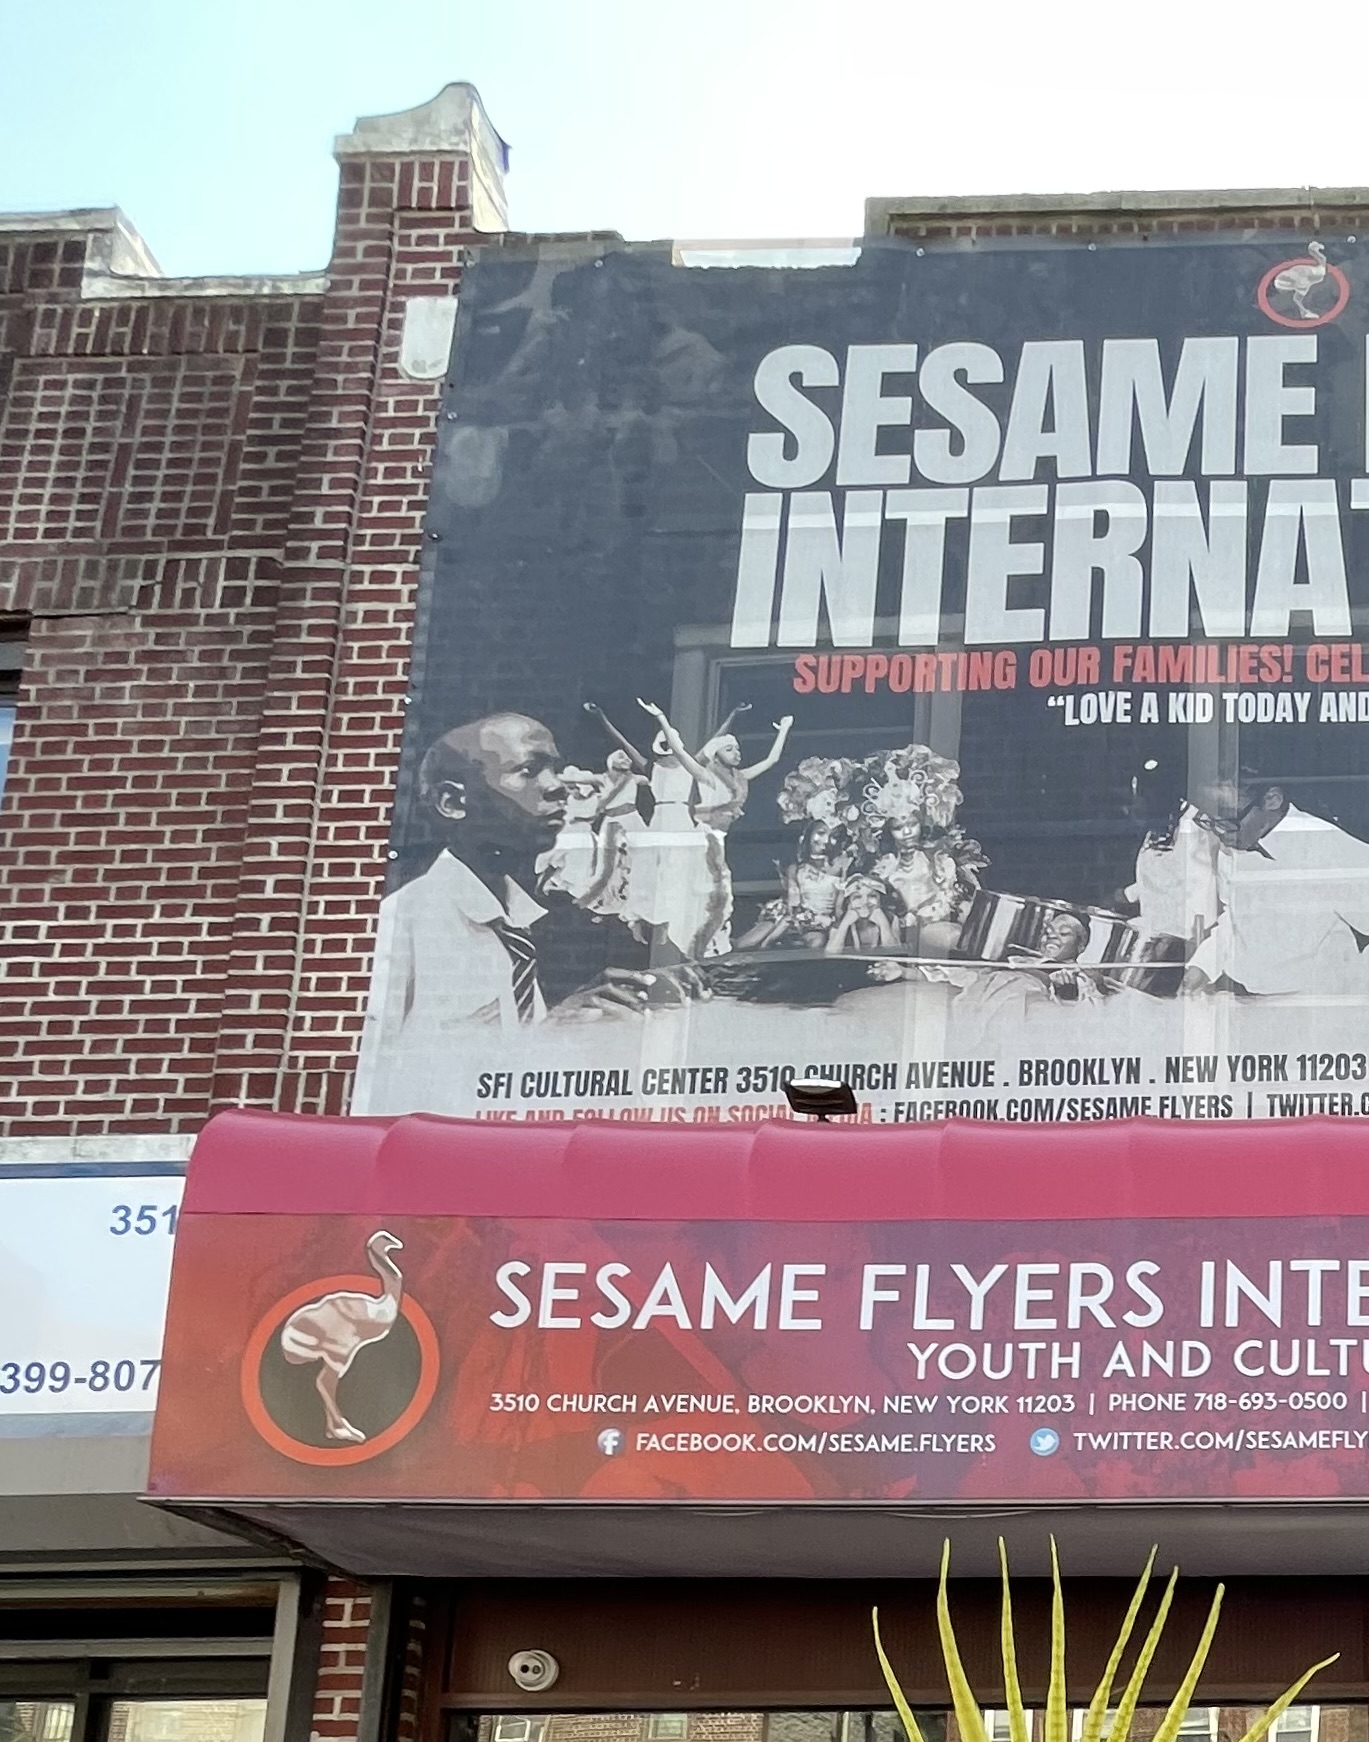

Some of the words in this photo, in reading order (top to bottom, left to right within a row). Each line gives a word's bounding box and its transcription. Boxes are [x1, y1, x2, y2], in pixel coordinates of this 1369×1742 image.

[746, 333, 1319, 488] SESAME
[793, 652, 1018, 694] SUPPORTING
[1029, 645, 1101, 688] OUR
[1112, 643, 1294, 684] FAMILIES!
[1047, 691, 1132, 726] “LOVE
[1140, 691, 1159, 724] A
[1169, 691, 1213, 724] KID
[1222, 692, 1311, 723] TODAY
[477, 1071, 513, 1099] SFI
[520, 1069, 633, 1098] CULTURAL
[641, 1067, 728, 1096] CENTER
[736, 1065, 796, 1093] 3510
[804, 1063, 898, 1090] CHURCH
[905, 1060, 995, 1089] AVENUE
[1018, 1057, 1141, 1086] BROOKLYN
[1165, 1055, 1218, 1083] NEW
[1227, 1054, 1288, 1082] YORK
[1296, 1053, 1367, 1081] 11203
[489, 1260, 826, 1331] SESAME
[860, 1260, 1164, 1331] FLYERS
[907, 1341, 1081, 1380] YOUTH
[1103, 1340, 1211, 1378] AND
[490, 1394, 540, 1413] 3510
[546, 1395, 637, 1414] CHURCH
[646, 1395, 741, 1416] AVENUE,
[748, 1395, 876, 1416] BROOKLYN,
[883, 1395, 938, 1414] NEW
[946, 1395, 1009, 1414] YORK
[1016, 1394, 1076, 1413] 11203
[1109, 1393, 1186, 1412] PHONE
[1193, 1391, 1348, 1411] 718-693-0500
[636, 1433, 996, 1453] FACEBOOK.COM/SESAME.FLYERS
